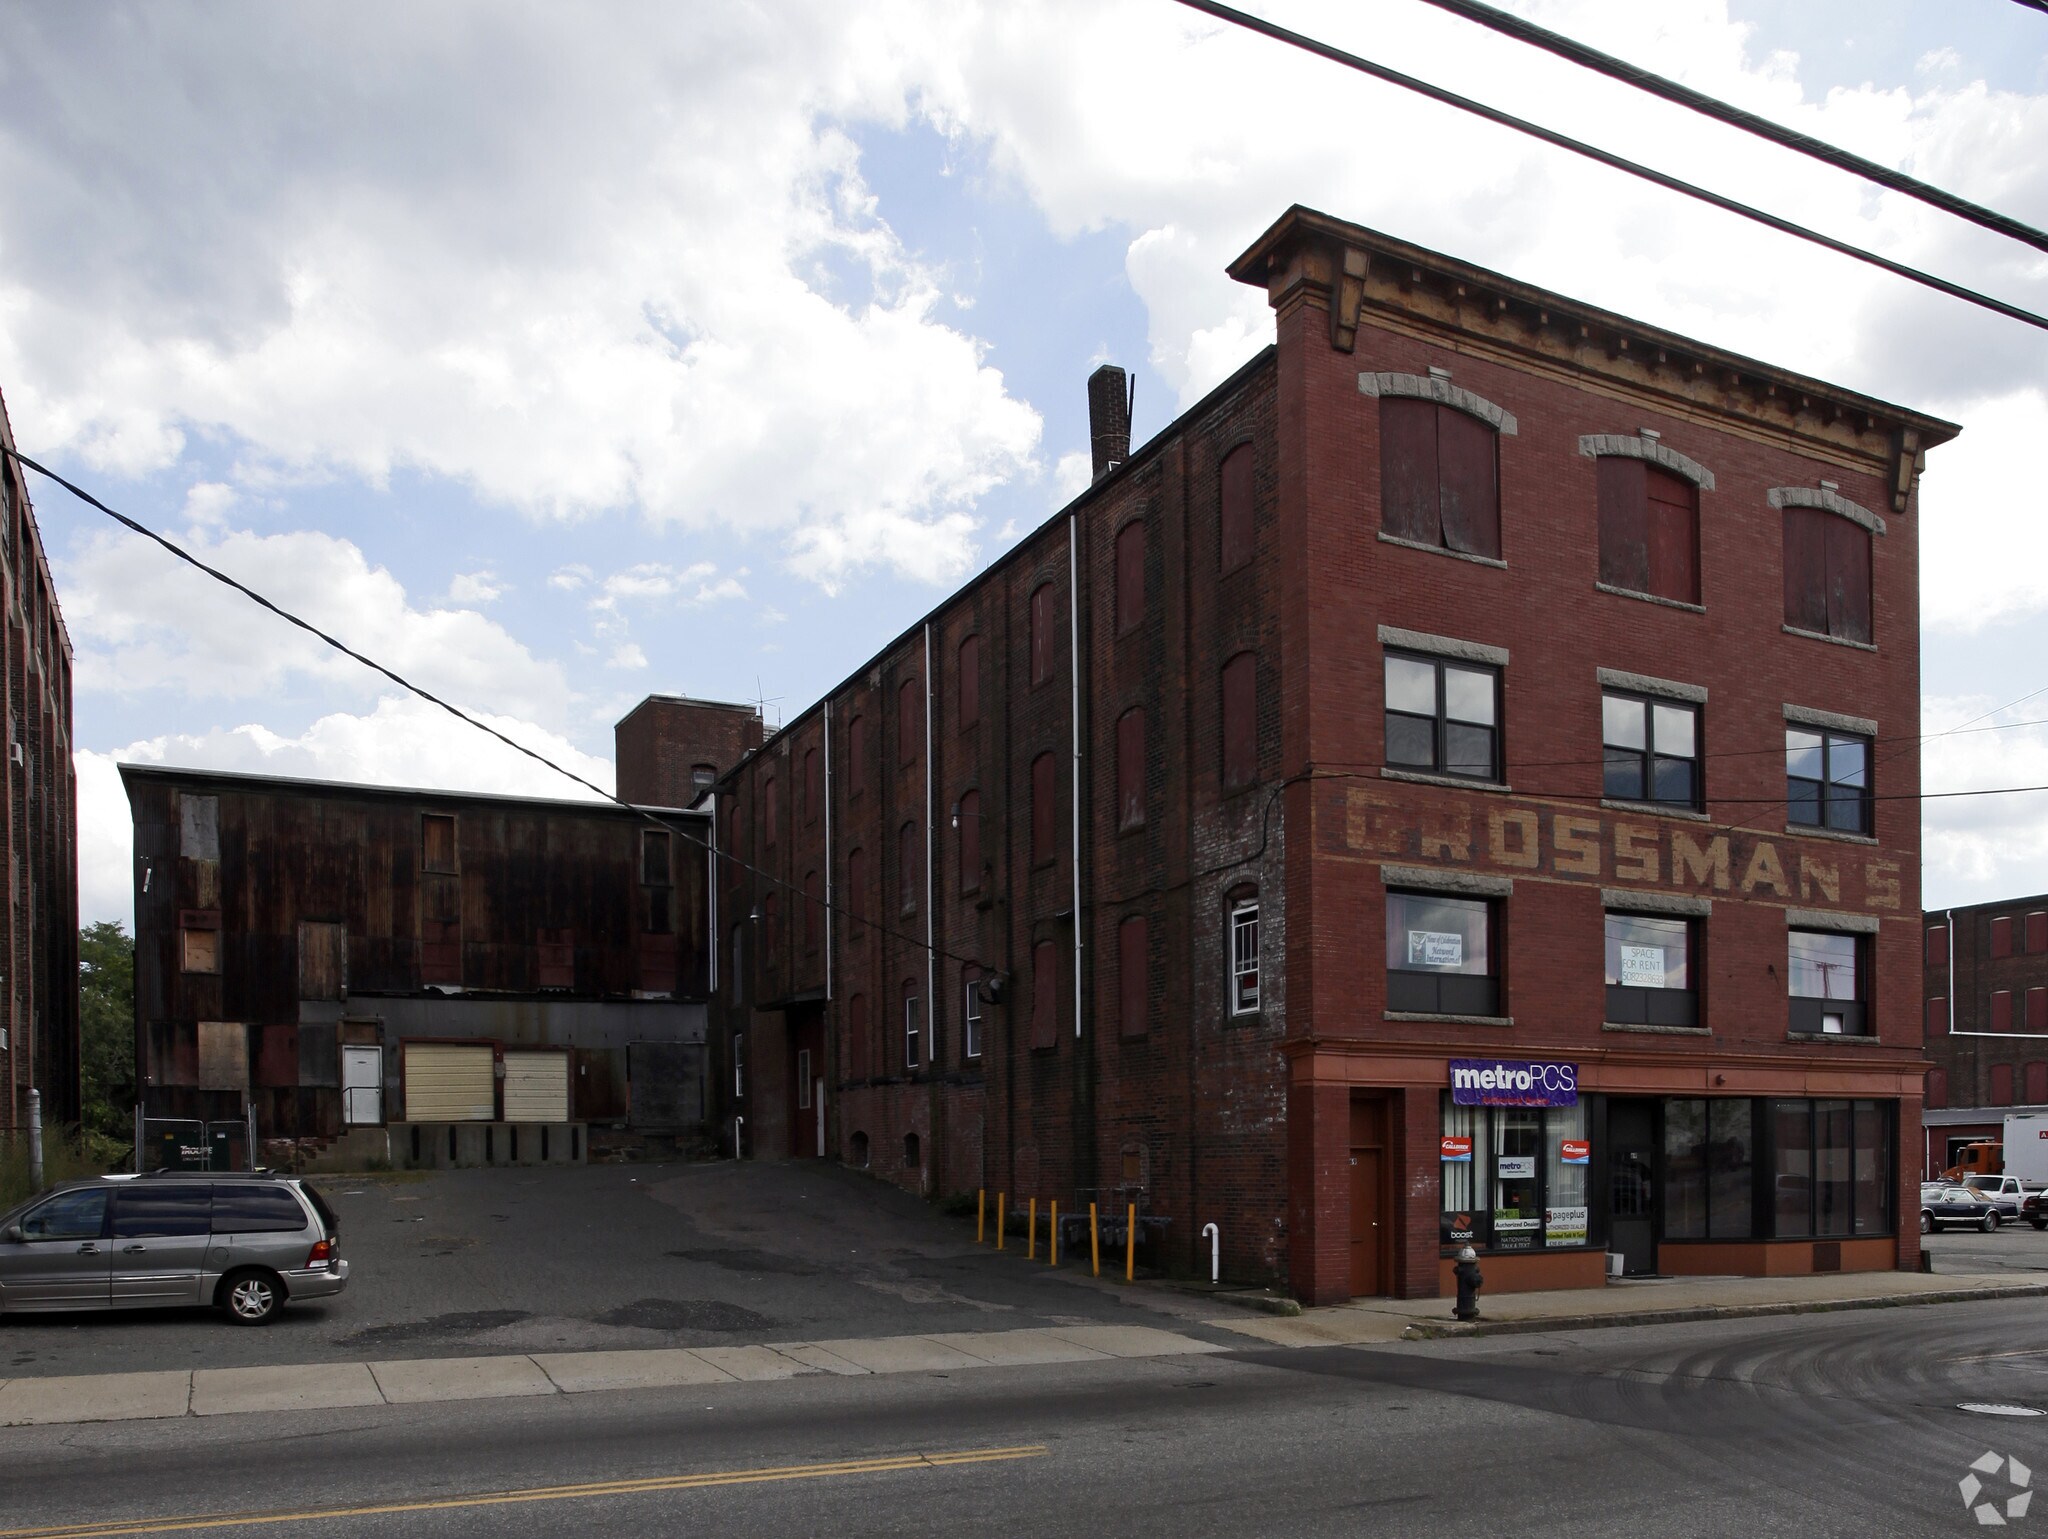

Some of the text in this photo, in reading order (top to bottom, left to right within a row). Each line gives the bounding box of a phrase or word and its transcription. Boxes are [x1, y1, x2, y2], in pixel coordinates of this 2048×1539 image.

[1631, 948, 1655, 959] SPACE
[1622, 959, 1660, 970] FOR RENT
[1454, 1064, 1575, 1091] metroPCS
[1553, 1209, 1585, 1221] pageplus
[1451, 1231, 1473, 1239] boost
